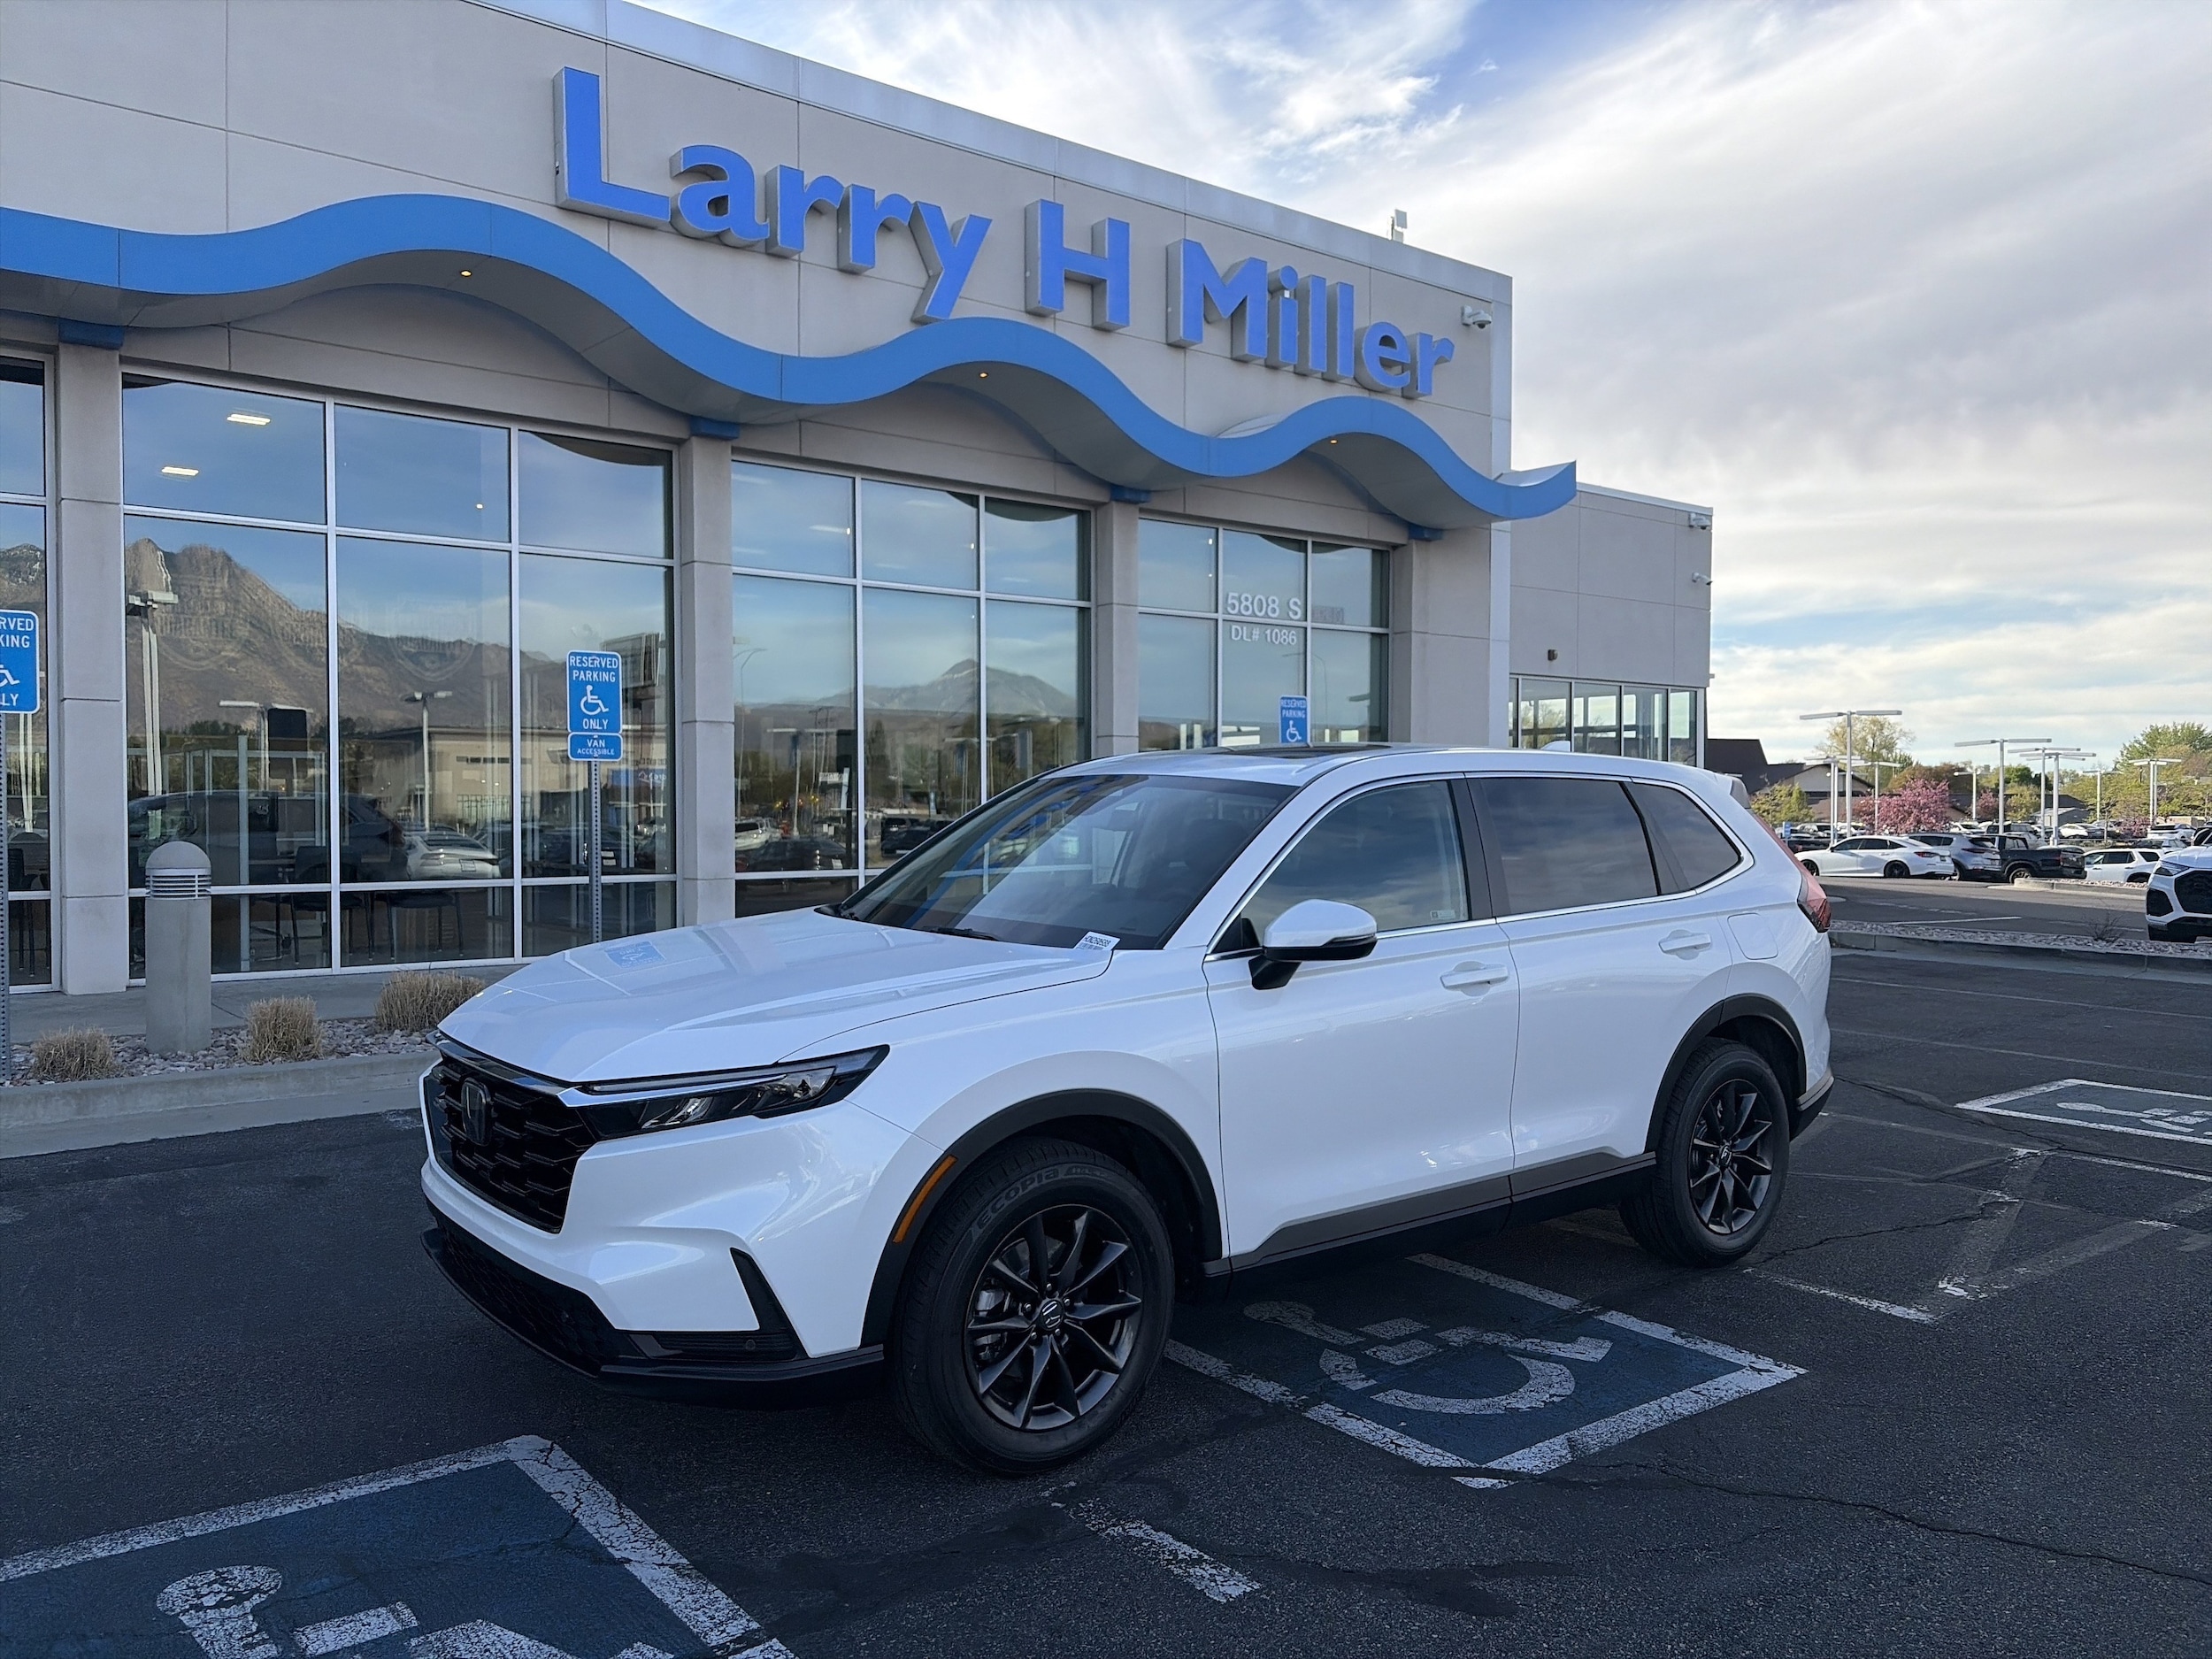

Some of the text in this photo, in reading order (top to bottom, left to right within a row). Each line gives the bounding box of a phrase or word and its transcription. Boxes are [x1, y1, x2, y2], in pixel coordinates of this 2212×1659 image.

[556, 66, 1455, 398] Larry H Miller
[1226, 592, 1302, 619] 5808 S
[1231, 625, 1297, 645] DL# 1086
[569, 656, 618, 669] RESERVED
[572, 670, 616, 682] PARKING
[582, 718, 609, 730] ONLY
[587, 739, 605, 748] VAN
